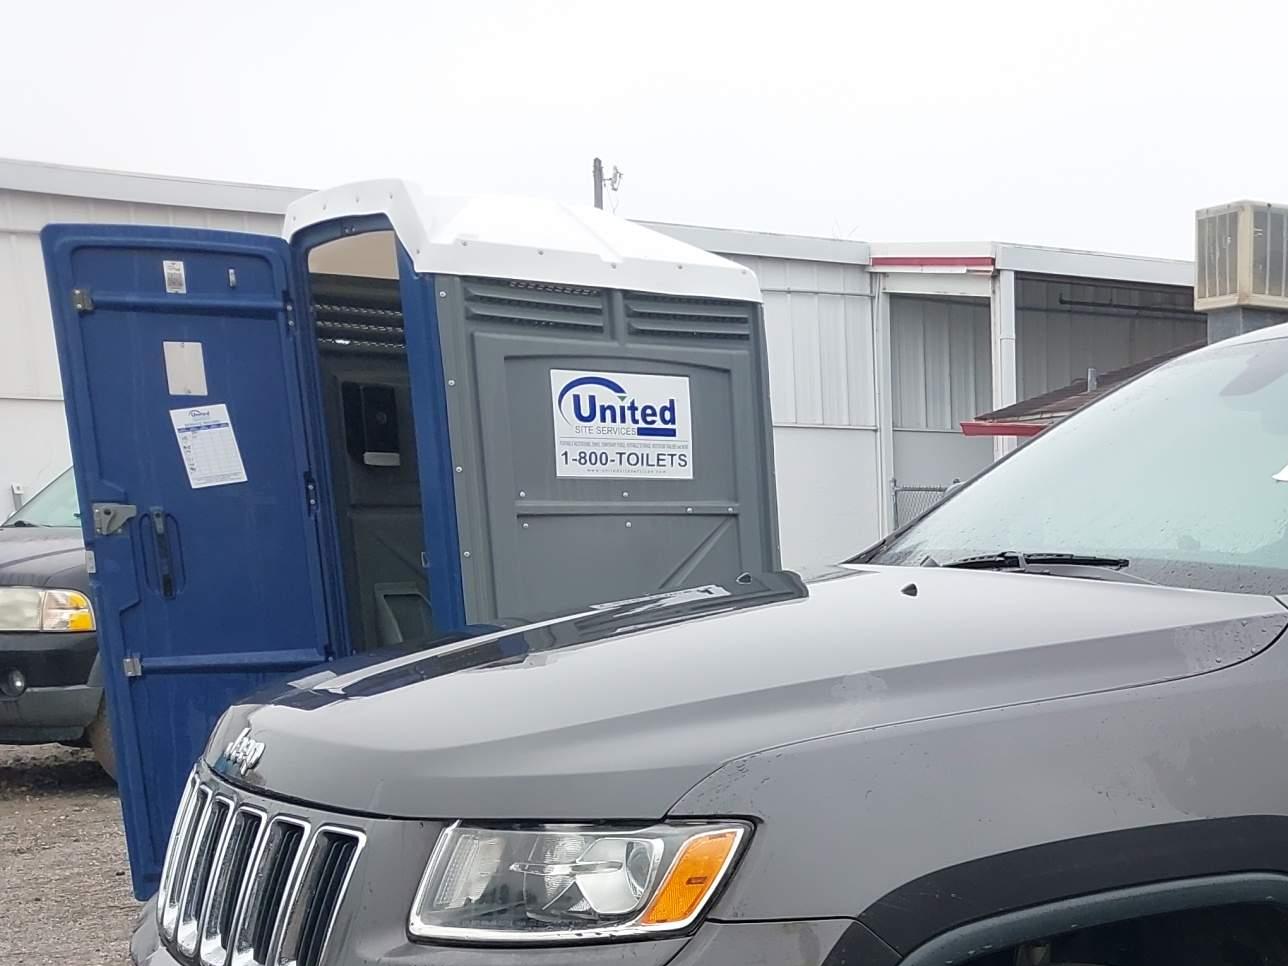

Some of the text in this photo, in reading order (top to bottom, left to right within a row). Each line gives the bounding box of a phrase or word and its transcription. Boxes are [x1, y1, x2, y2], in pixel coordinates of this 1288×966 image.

[573, 394, 676, 425] United
[575, 426, 636, 436] SITE SERVICES
[561, 451, 688, 468] 1-800-TOILETS
[225, 728, 265, 776] Jeep
